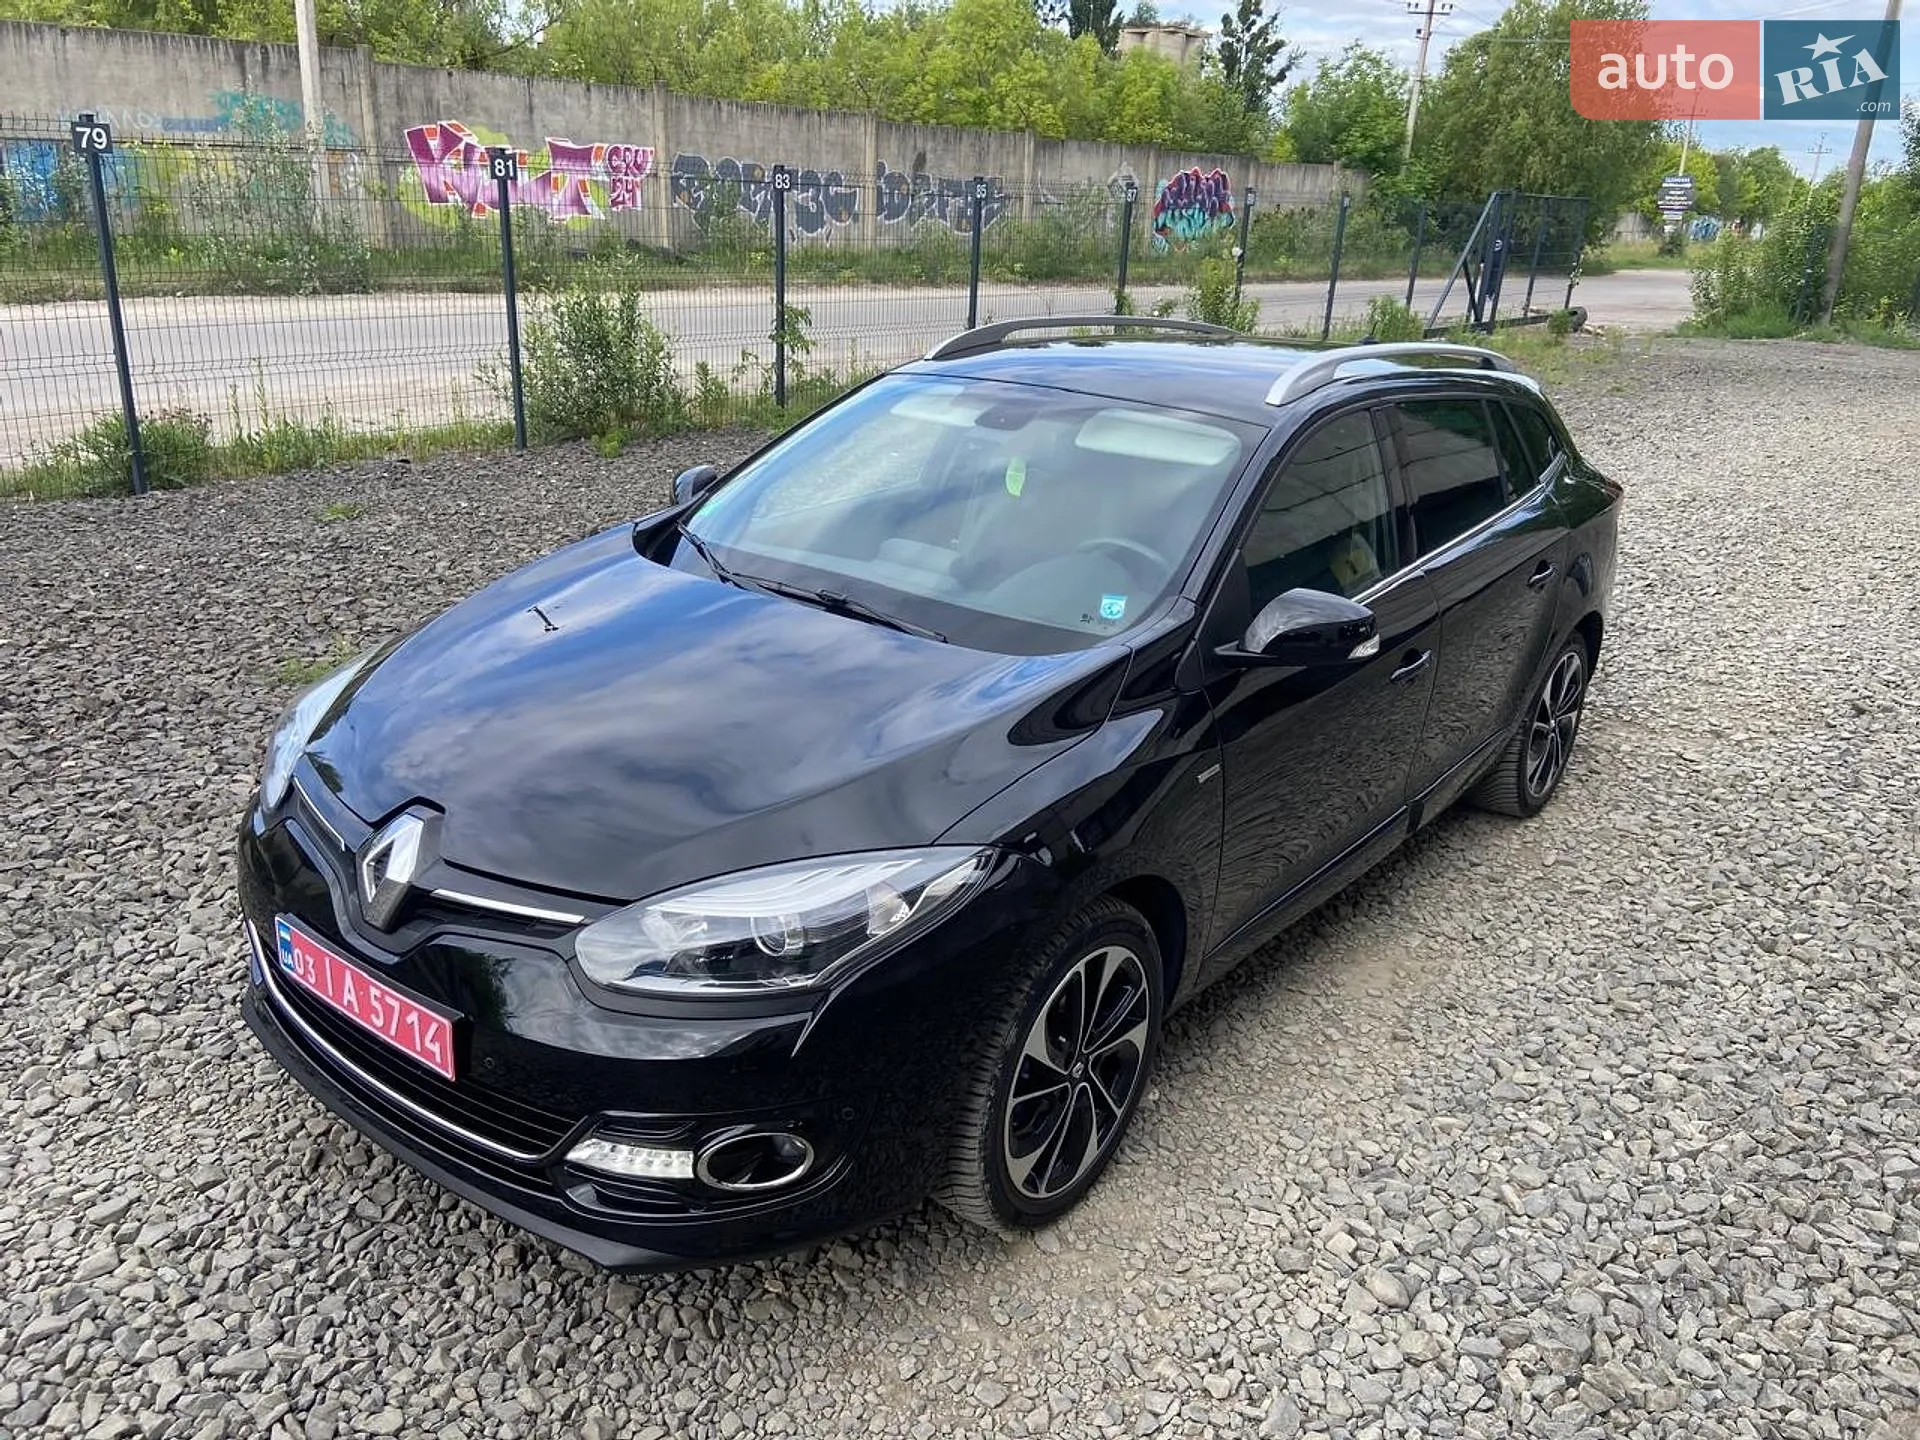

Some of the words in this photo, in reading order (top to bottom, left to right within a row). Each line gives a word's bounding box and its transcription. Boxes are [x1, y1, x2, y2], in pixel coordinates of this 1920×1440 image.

[75, 127, 107, 149] 79
[494, 158, 514, 177] 81
[775, 173, 790, 189] 83
[281, 949, 295, 969] UA
[368, 984, 443, 1063] 5714
